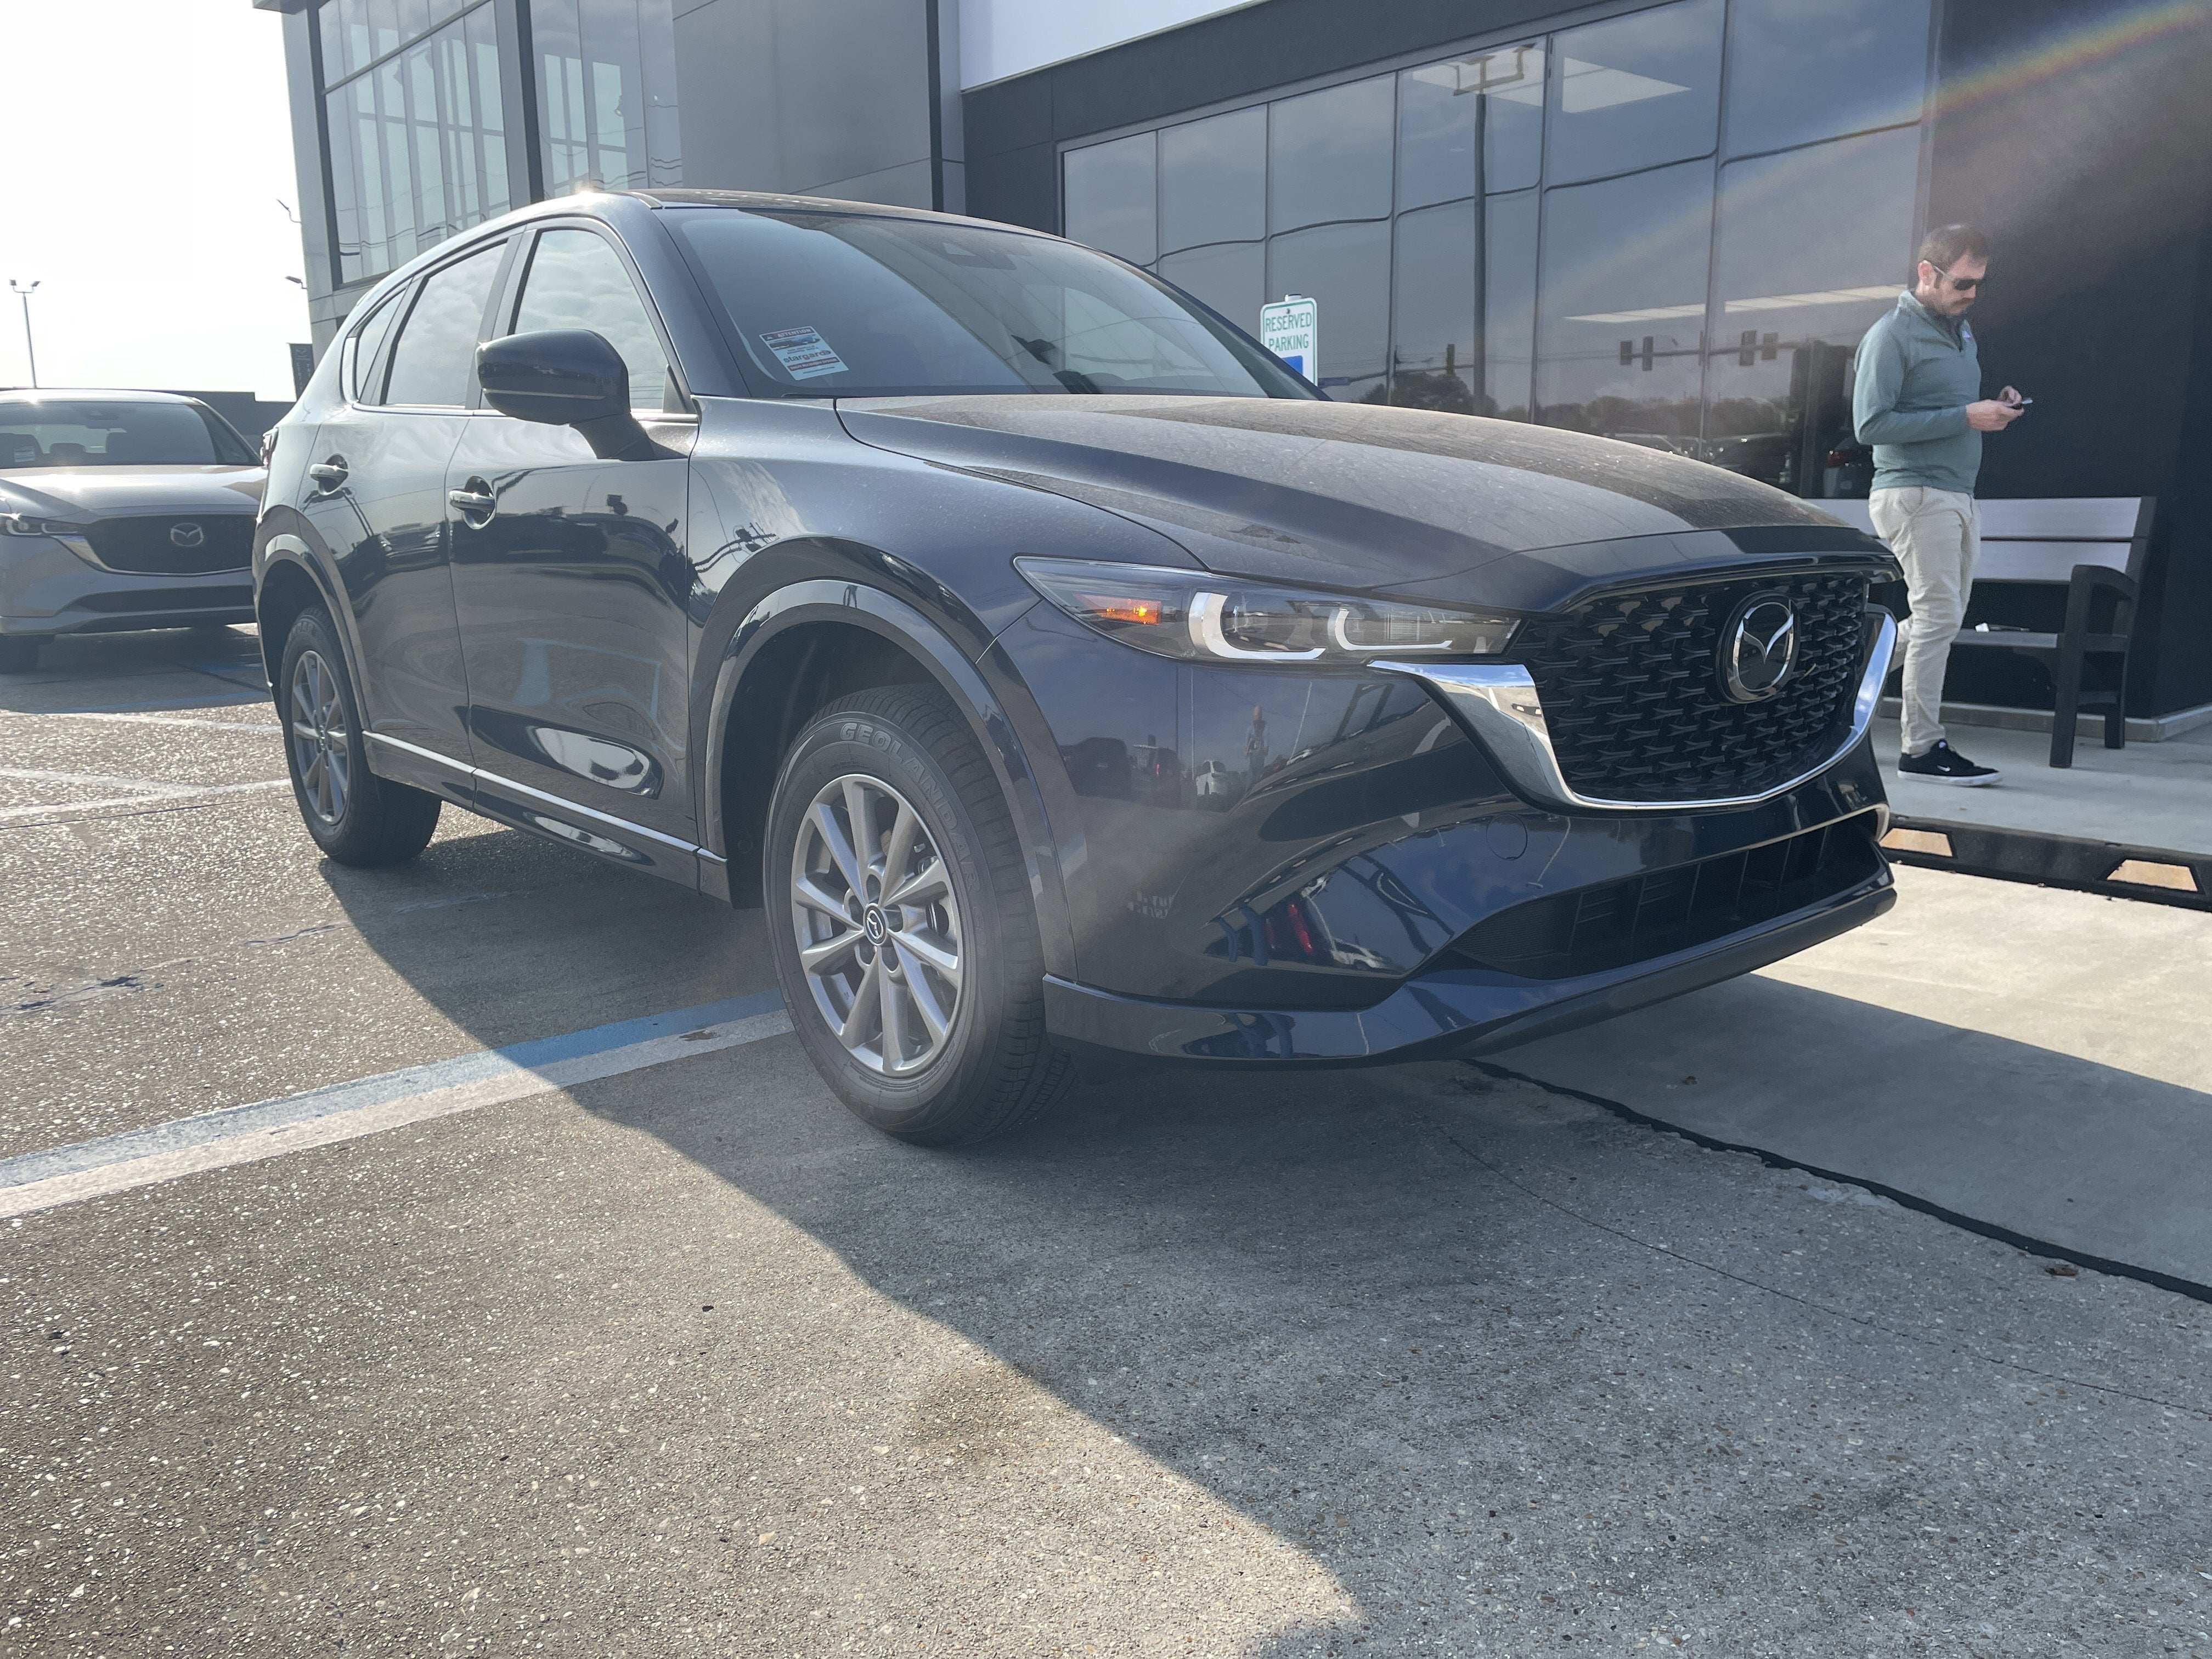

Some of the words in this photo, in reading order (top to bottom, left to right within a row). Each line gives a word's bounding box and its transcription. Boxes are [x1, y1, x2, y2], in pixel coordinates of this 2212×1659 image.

[1265, 312, 1312, 332] RESERVED
[777, 328, 812, 338] ATTENTION
[1269, 334, 1309, 352] PARKING
[840, 722, 981, 894] GEOLANDAR
